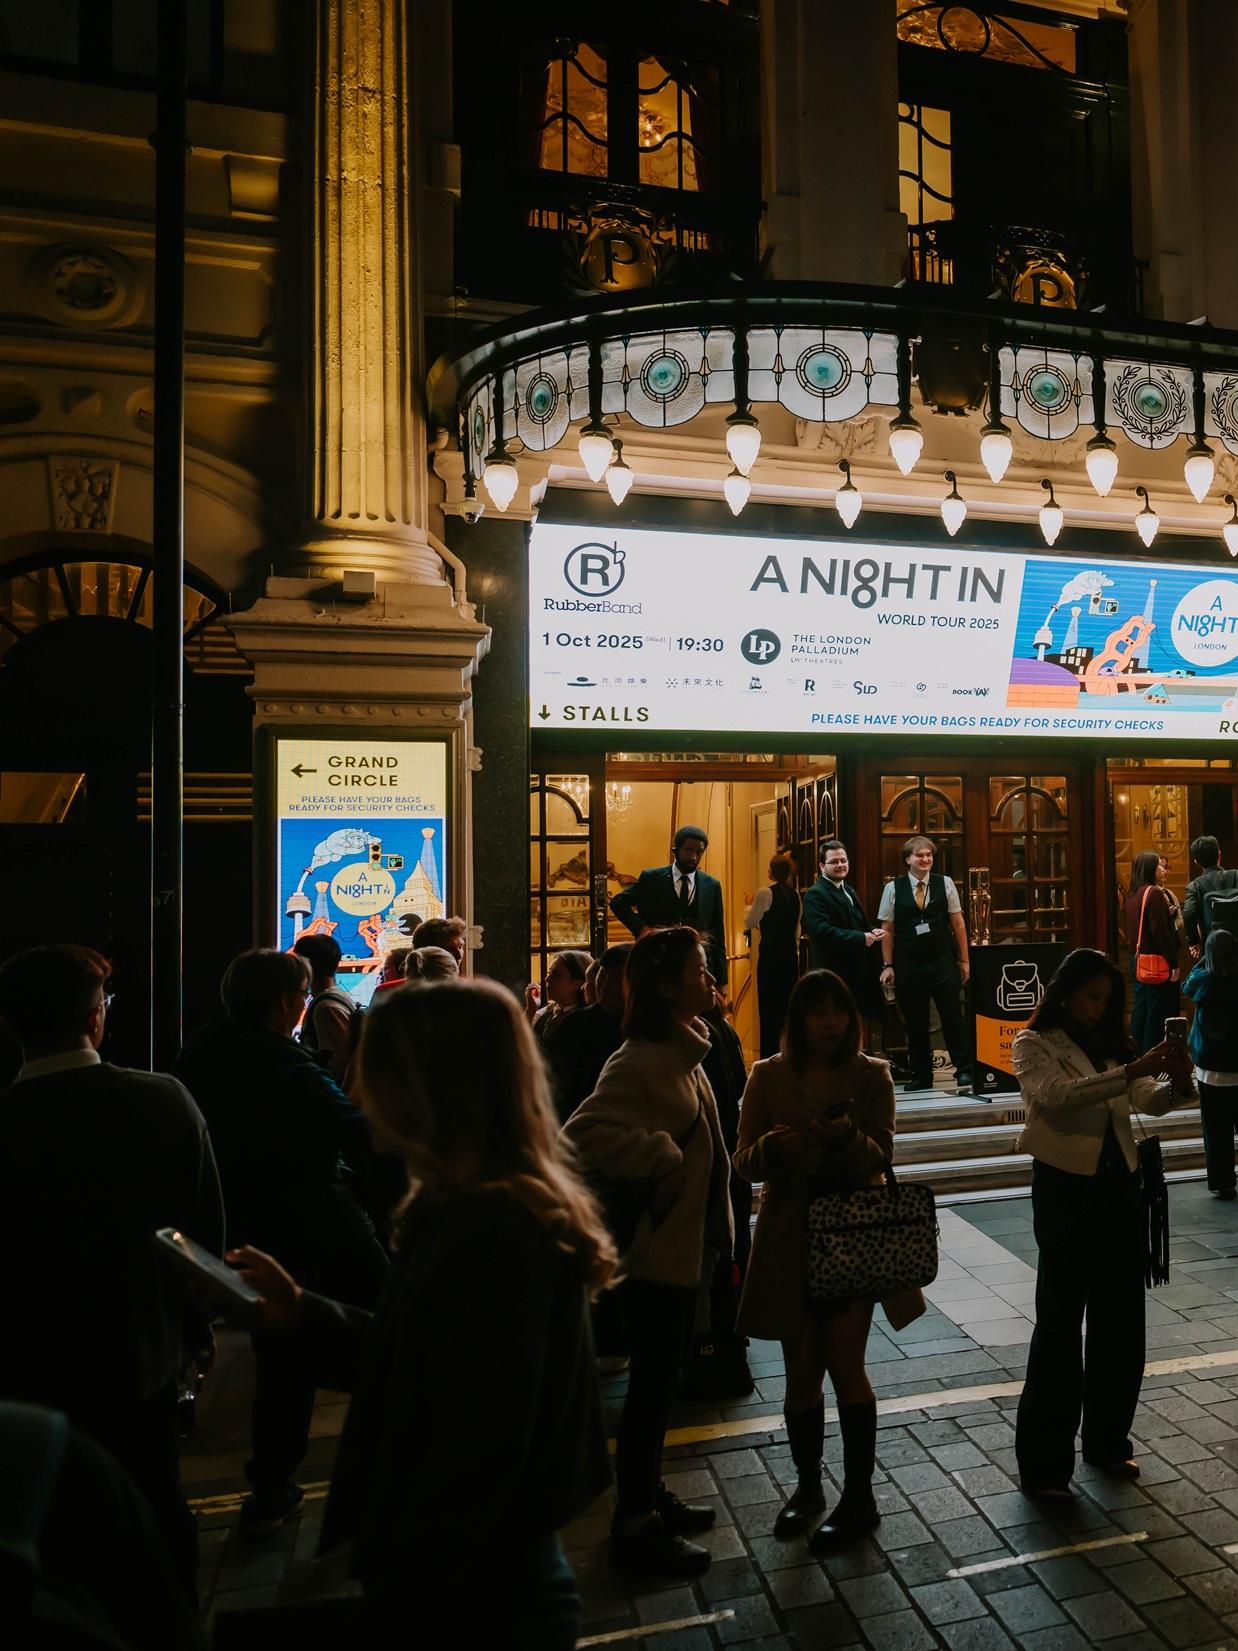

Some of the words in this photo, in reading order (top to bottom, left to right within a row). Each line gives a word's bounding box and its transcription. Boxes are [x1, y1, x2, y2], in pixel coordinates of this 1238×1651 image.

[749, 555, 790, 593] A
[957, 567, 1006, 604] IN
[544, 598, 643, 615] RubberBand
[1209, 595, 1223, 611] A
[877, 613, 926, 628] WORLD
[930, 615, 966, 629] TOUR
[969, 616, 1000, 630] 2025
[542, 632, 550, 646] 1
[556, 632, 591, 647] Oct
[597, 635, 643, 649] 2025
[676, 637, 724, 652] 19:30
[793, 634, 816, 643] THE
[820, 635, 871, 645] LONDON
[791, 645, 859, 656] PALLADIUM
[1193, 642, 1228, 651] LONDON
[562, 705, 650, 722] STALLS
[812, 713, 860, 725] PLEASE
[864, 714, 898, 725] HAVE
[902, 715, 938, 726] YOUR
[941, 716, 976, 727] BAGS
[980, 717, 1021, 728] READY
[1024, 718, 1050, 729] FOR
[1052, 718, 1113, 730] SECURITY
[1114, 719, 1164, 731] CHECKS
[328, 755, 398, 768] GRAND
[328, 774, 398, 787] CIRCLE
[301, 796, 337, 804] PLEASE
[339, 796, 364, 804] HAVE
[367, 796, 393, 804] YOUR
[395, 796, 421, 804] BAGS
[288, 804, 321, 812] READY
[324, 804, 344, 812] FOR
[346, 804, 393, 812] SECURITY
[396, 804, 436, 812] CHECKS
[358, 872, 368, 882] A
